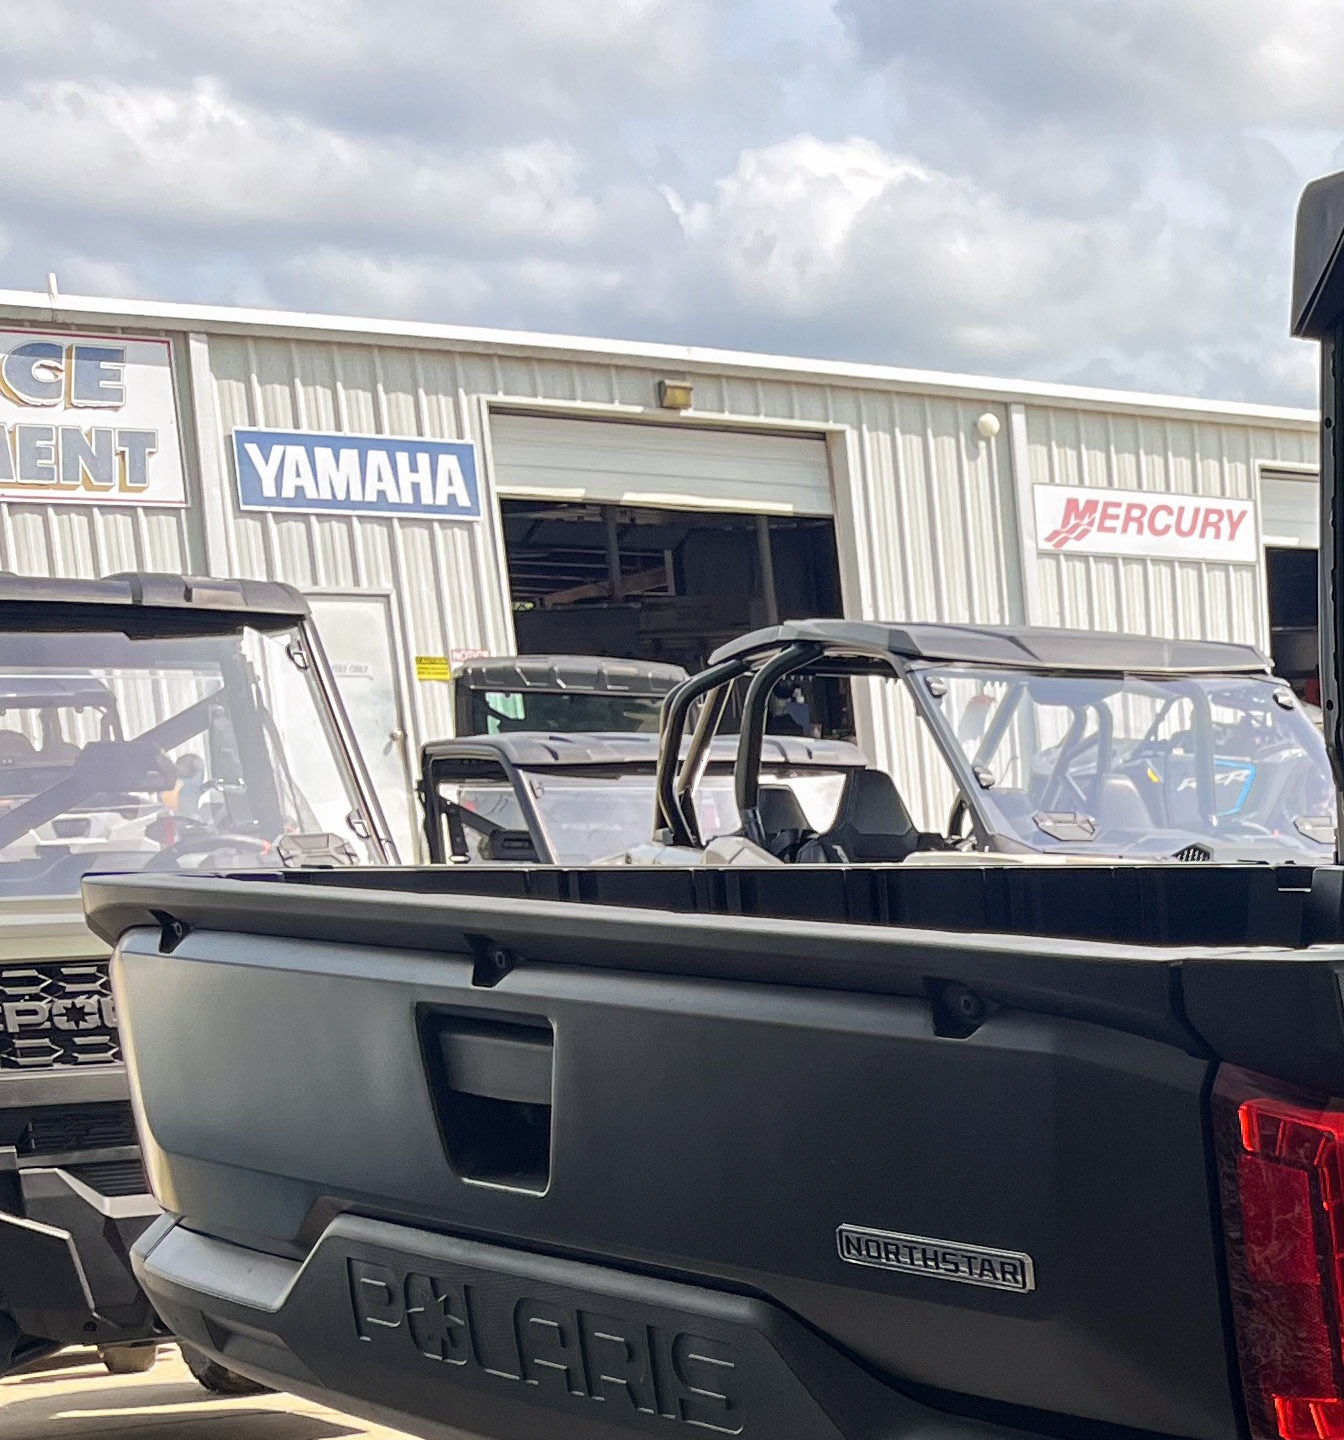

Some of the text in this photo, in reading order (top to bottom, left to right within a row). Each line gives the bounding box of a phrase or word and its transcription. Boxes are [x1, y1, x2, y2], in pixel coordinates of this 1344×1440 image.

[0, 340, 127, 411] CE
[244, 443, 472, 507] YAMAHA
[1044, 498, 1249, 549] MERCURY
[844, 1234, 1023, 1284] NORTHSTAR
[346, 1257, 744, 1435] POLARIS
